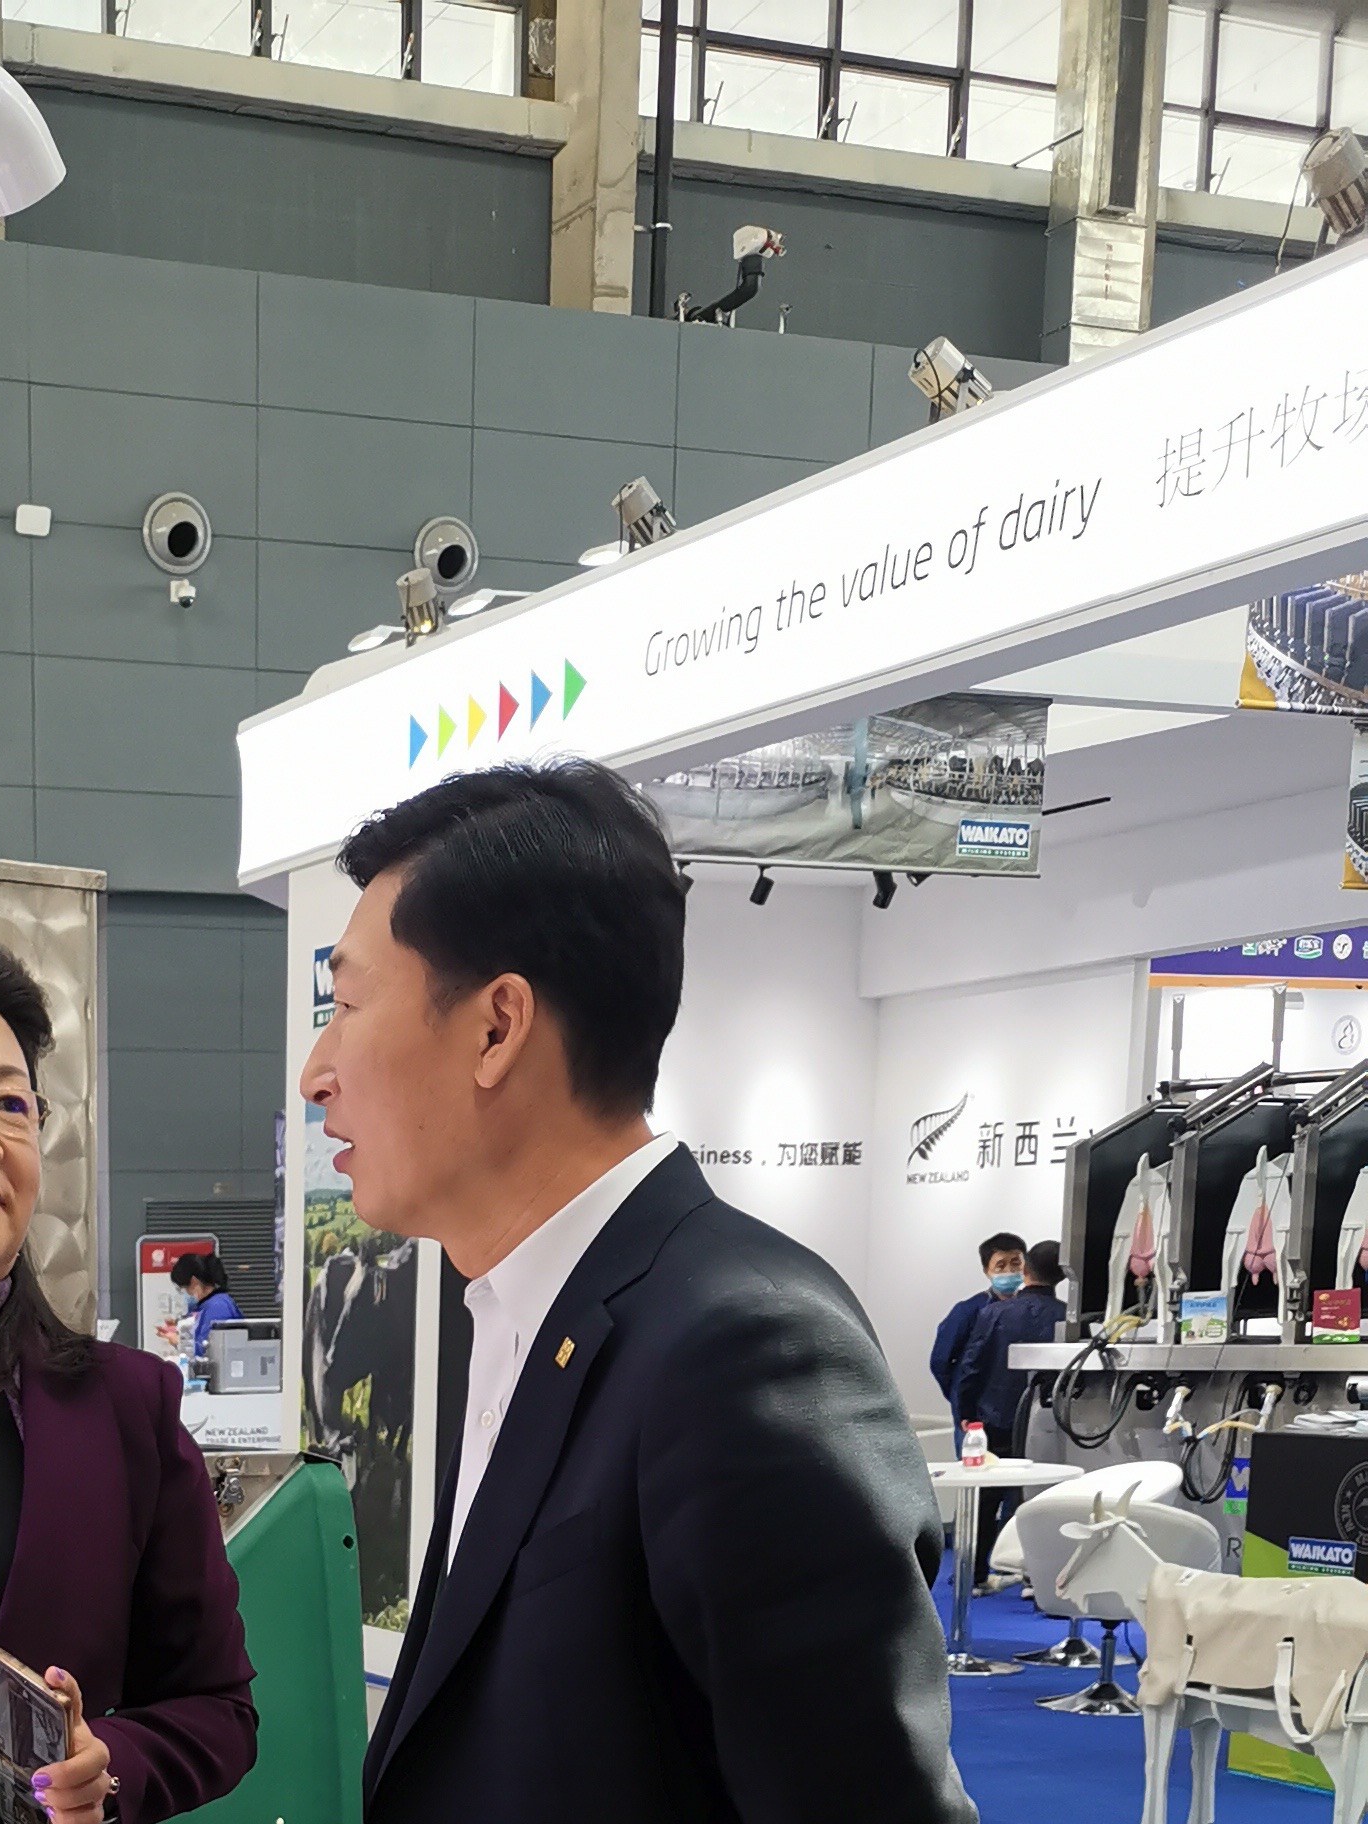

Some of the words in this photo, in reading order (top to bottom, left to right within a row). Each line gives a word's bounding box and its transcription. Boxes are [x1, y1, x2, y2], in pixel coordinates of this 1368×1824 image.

[1155, 369, 1368, 509] 提升牧场
[643, 605, 763, 677] Growing
[776, 580, 827, 632] the
[841, 542, 934, 608] value
[947, 505, 989, 575] of
[997, 477, 1102, 551] dairy
[960, 824, 1029, 846] WAIKATO
[777, 1141, 863, 1167] 为您赋能
[976, 1116, 1093, 1169] 新西兰
[906, 1173, 926, 1185] NEW
[928, 1170, 970, 1184] ZEALAND
[205, 1427, 227, 1437] NEW
[228, 1426, 270, 1437] ZEALAND
[1291, 1543, 1353, 1564] WAIKATO
